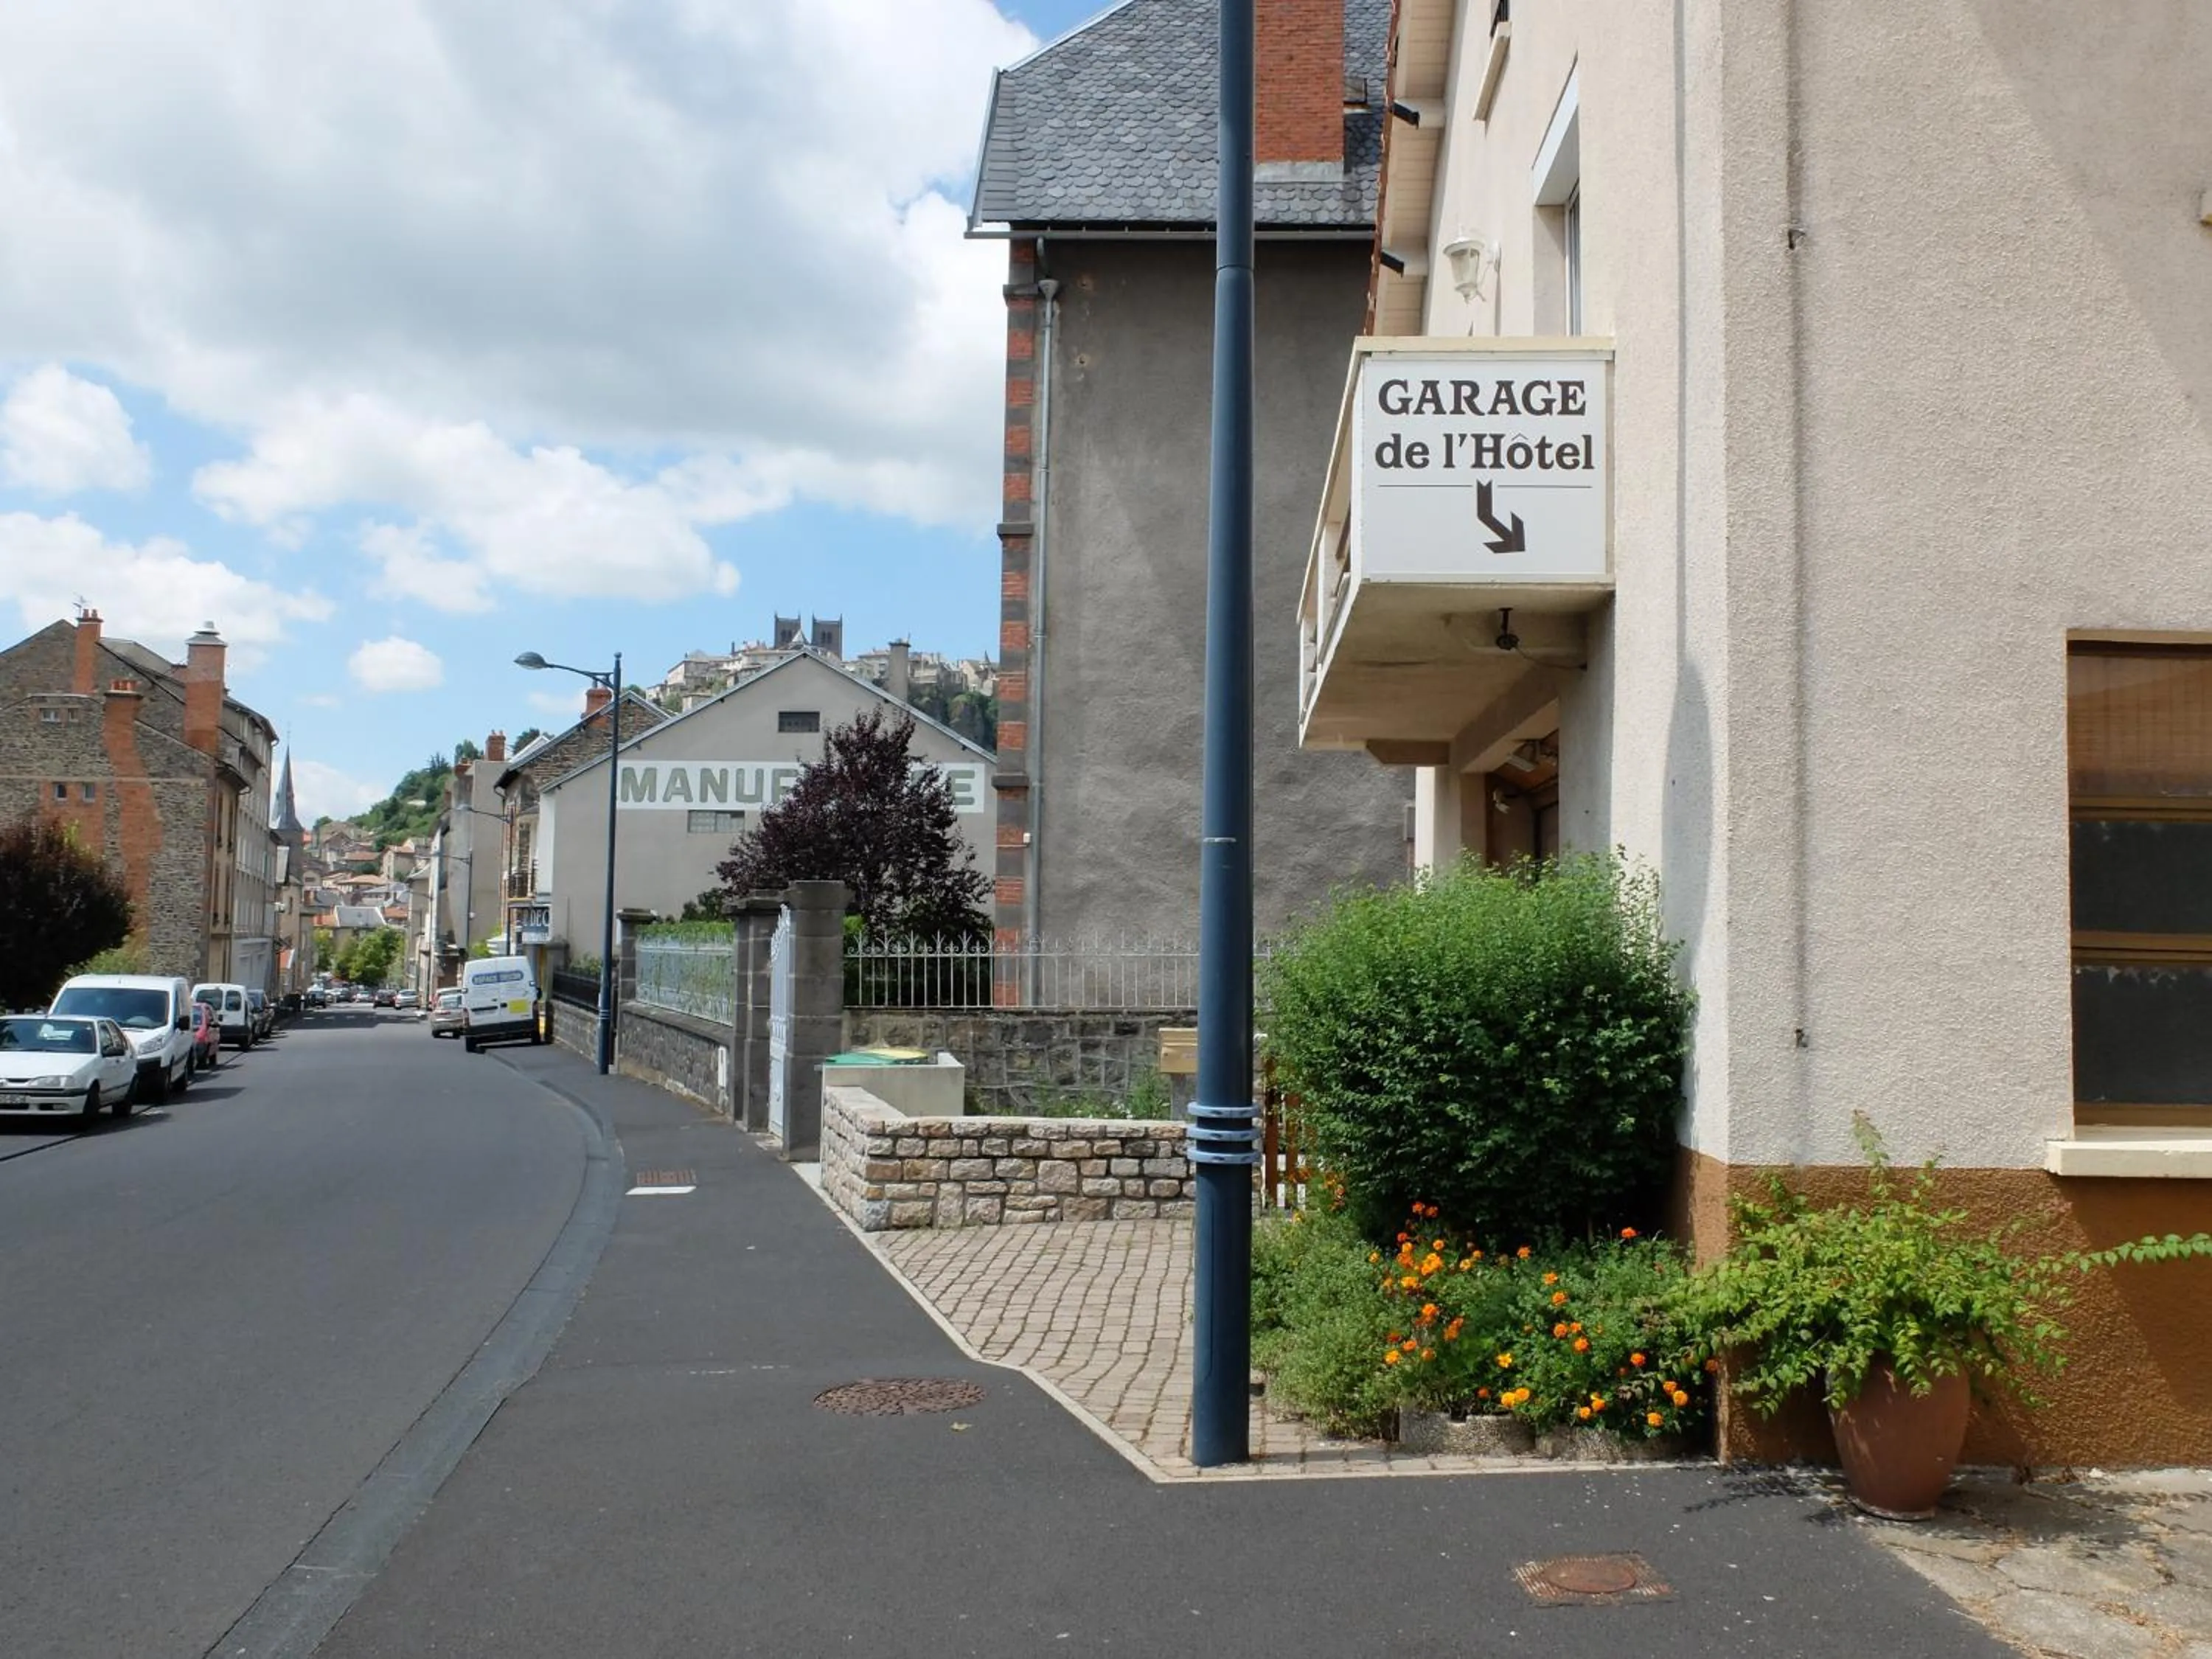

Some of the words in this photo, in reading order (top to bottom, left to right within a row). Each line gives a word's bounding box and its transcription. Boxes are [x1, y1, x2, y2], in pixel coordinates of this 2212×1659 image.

[1377, 379, 1586, 416] GARAGE
[1374, 433, 1430, 470] de
[1443, 433, 1595, 470] l'Hôtel
